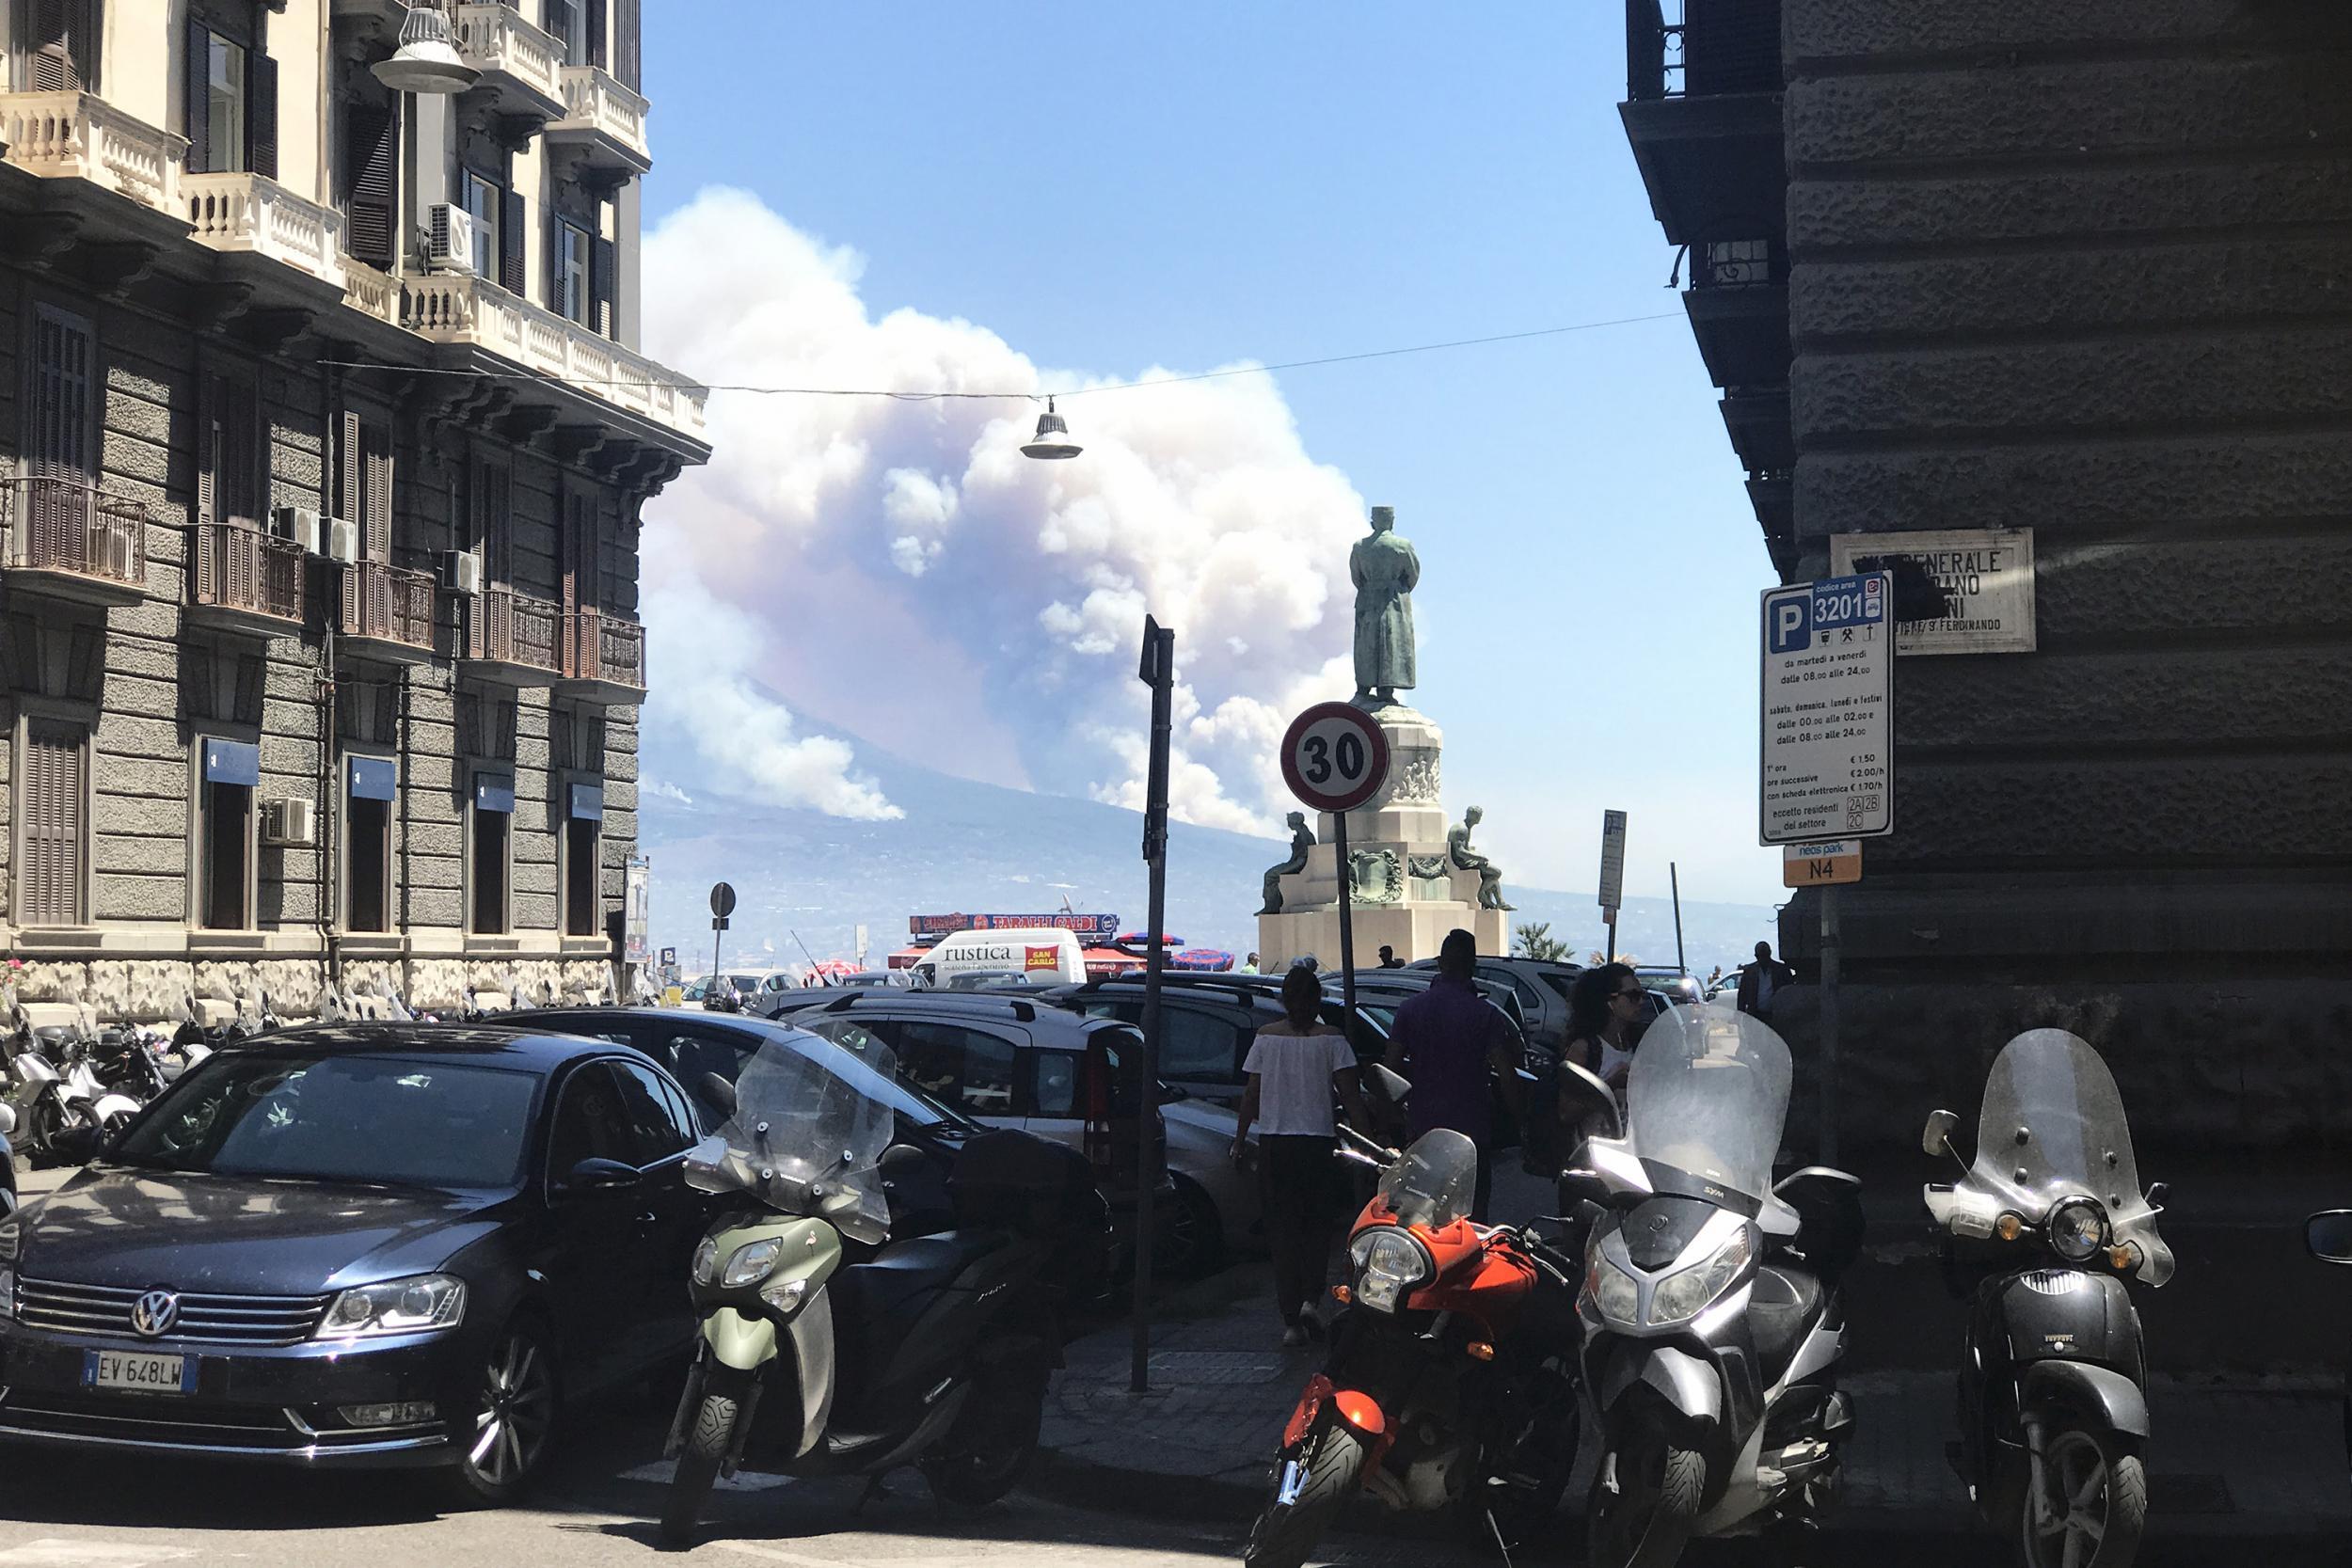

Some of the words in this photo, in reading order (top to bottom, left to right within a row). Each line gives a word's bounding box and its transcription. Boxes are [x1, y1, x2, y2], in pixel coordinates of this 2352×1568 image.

[1817, 583, 1839, 593] codice
[1841, 581, 1856, 590] area
[1815, 594, 1862, 623] 3201
[1779, 604, 1803, 646] P
[1941, 619, 2001, 632] FERDINANDO
[1781, 674, 1801, 684] dalle
[1829, 669, 1844, 678] alle
[1776, 720, 1796, 730] dalle
[1825, 714, 1840, 723] alle
[1776, 736, 1796, 745] dalle
[1825, 730, 1840, 739] alle
[1304, 732, 1364, 784] 30
[1780, 775, 1819, 785] successive
[1782, 788, 1806, 799] scheda
[1809, 784, 1849, 796] elettronica
[1772, 808, 1802, 818] eccetto
[1804, 802, 1839, 815] residenti
[1850, 799, 1862, 811] 2A
[1866, 797, 1878, 810] 2B
[1784, 820, 1796, 831] del
[1798, 818, 1826, 829] settore
[1850, 814, 1862, 828] 2C
[1800, 845, 1821, 857] neos
[1823, 843, 1844, 855] park
[1810, 859, 1834, 879] N4
[993, 916, 1053, 929] TARALLI
[1054, 916, 1098, 931] CALDI
[945, 942, 1011, 960] rustica
[99, 1357, 121, 1381] EV
[126, 1359, 182, 1386] 648LW
